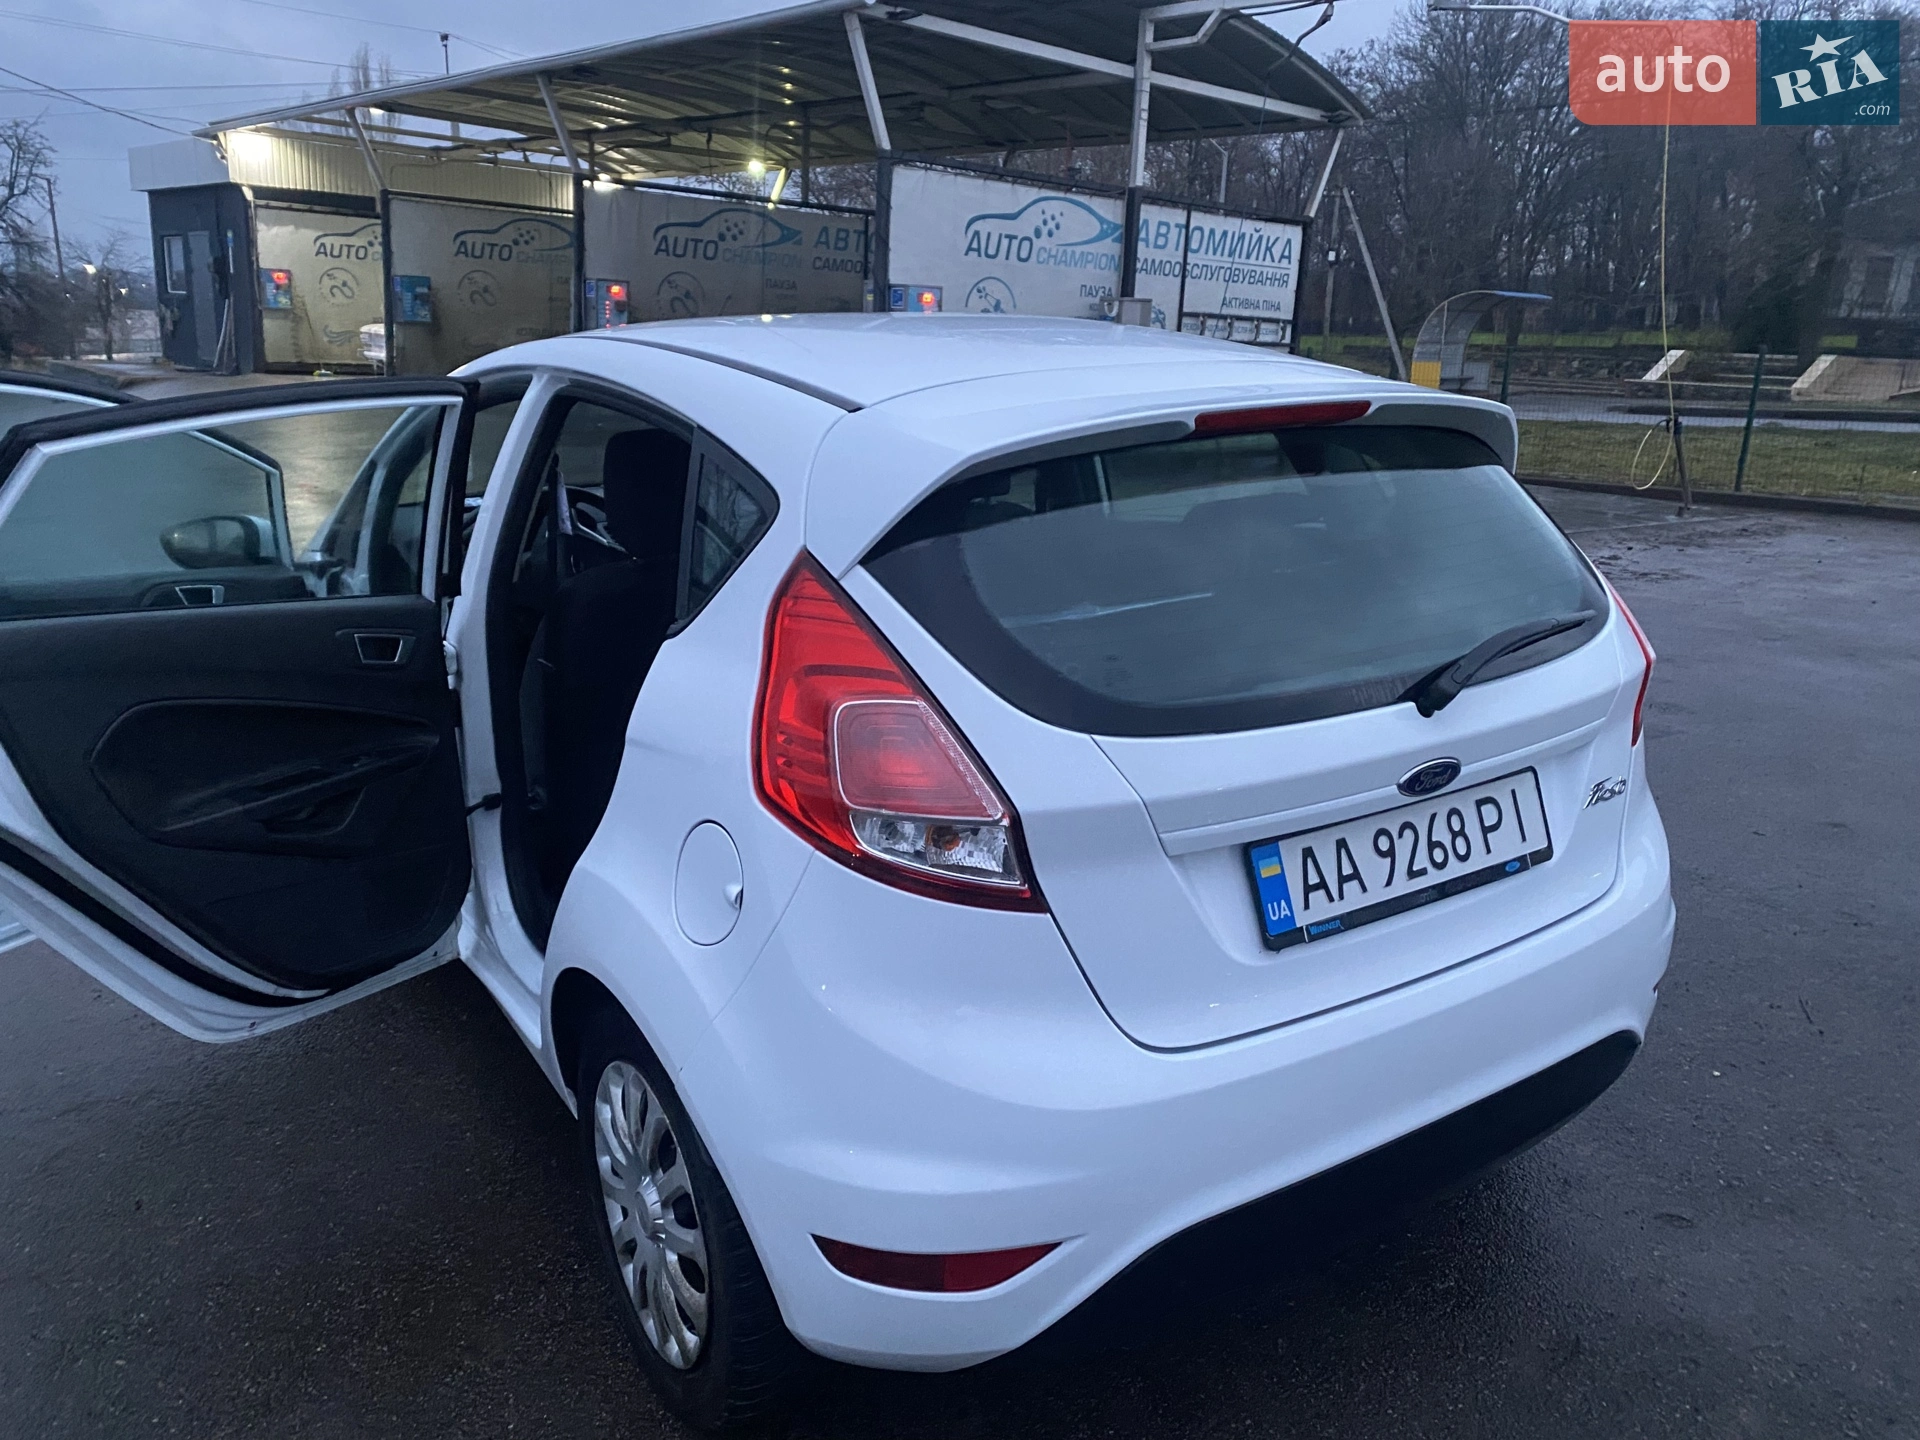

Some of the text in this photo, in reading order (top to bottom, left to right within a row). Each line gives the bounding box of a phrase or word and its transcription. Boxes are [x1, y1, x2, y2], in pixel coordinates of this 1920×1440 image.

[315, 242, 368, 260] AUTO
[454, 240, 513, 262] AUTO
[654, 234, 719, 261] AUTO
[964, 230, 1122, 273] AUTO CHAMPION
[1138, 218, 1293, 265] АВТОМИЙКА
[1080, 284, 1113, 298] ПАУЗА
[1222, 296, 1281, 313] АКТИВНА ПІНА
[1415, 768, 1450, 791] Ford
[1301, 788, 1527, 911] AA 9268 PI
[1268, 899, 1292, 921] UA
